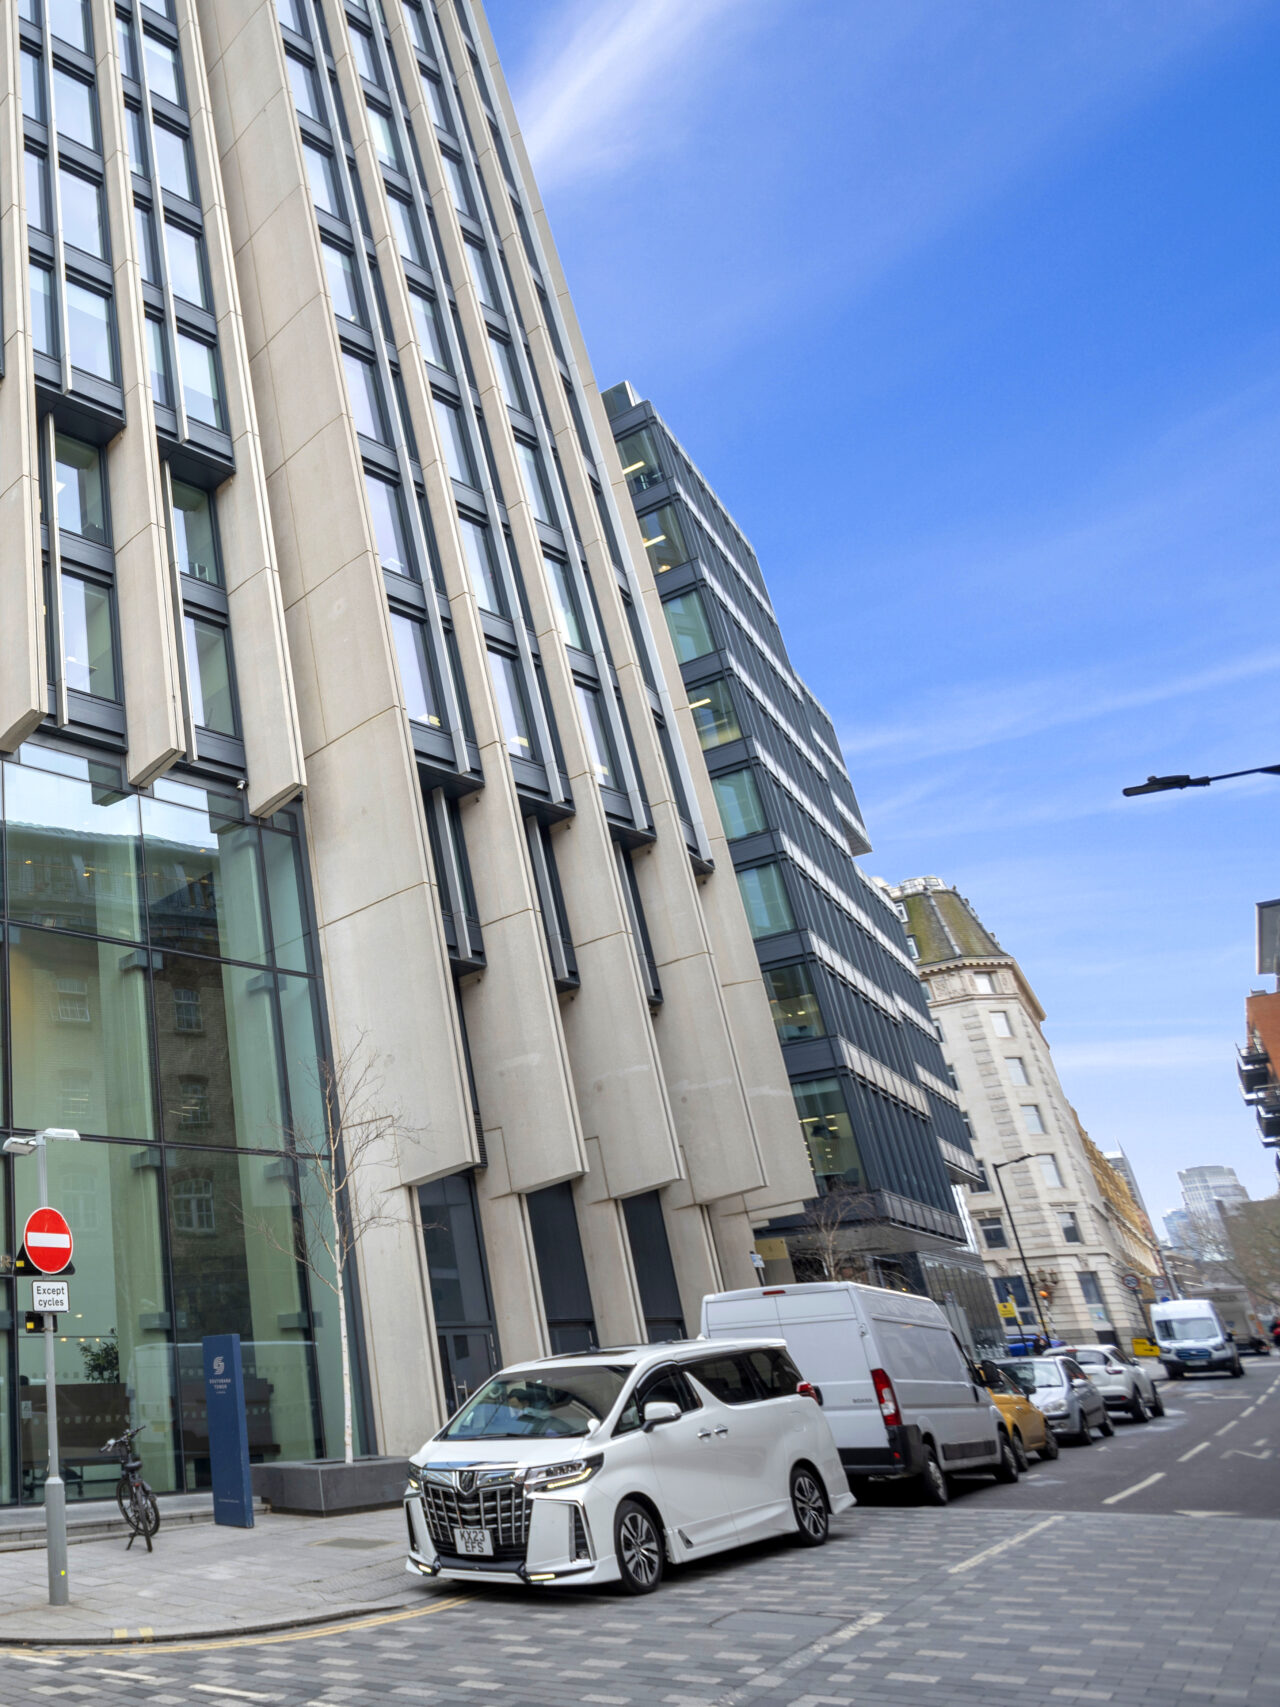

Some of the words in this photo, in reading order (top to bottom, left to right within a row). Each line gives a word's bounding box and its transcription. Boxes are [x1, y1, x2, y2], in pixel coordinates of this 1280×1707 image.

[36, 1285, 65, 1296] Except
[38, 1297, 64, 1308] cycles
[459, 1530, 486, 1542] KX23
[465, 1541, 484, 1553] EFS
